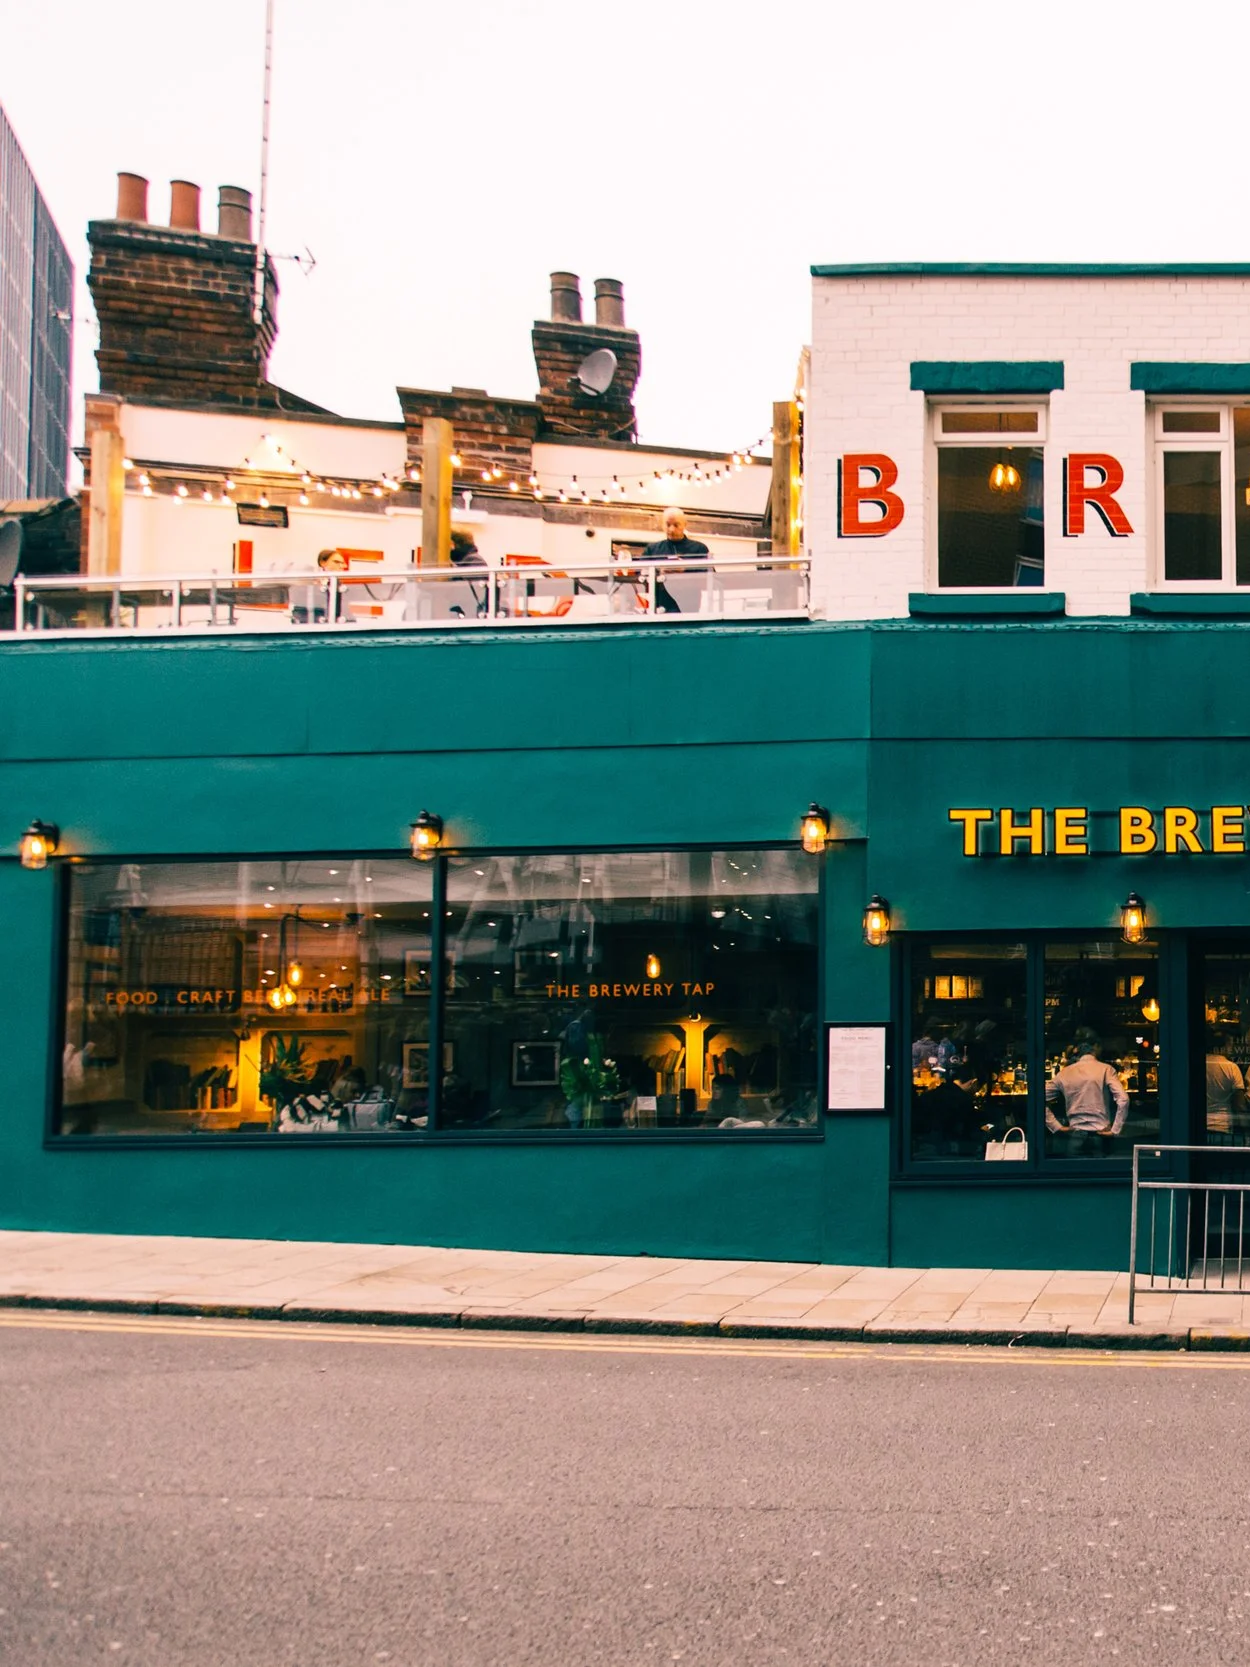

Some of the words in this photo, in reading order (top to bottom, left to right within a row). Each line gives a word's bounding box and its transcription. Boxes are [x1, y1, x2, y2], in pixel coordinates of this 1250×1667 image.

[948, 807, 1089, 857] THE
[106, 992, 158, 1006] FOOD
[176, 990, 236, 1004] CRAFT
[307, 988, 351, 1002] REAL
[545, 984, 581, 998] THE
[589, 983, 674, 998] BREWERY
[682, 982, 715, 995] TAP
